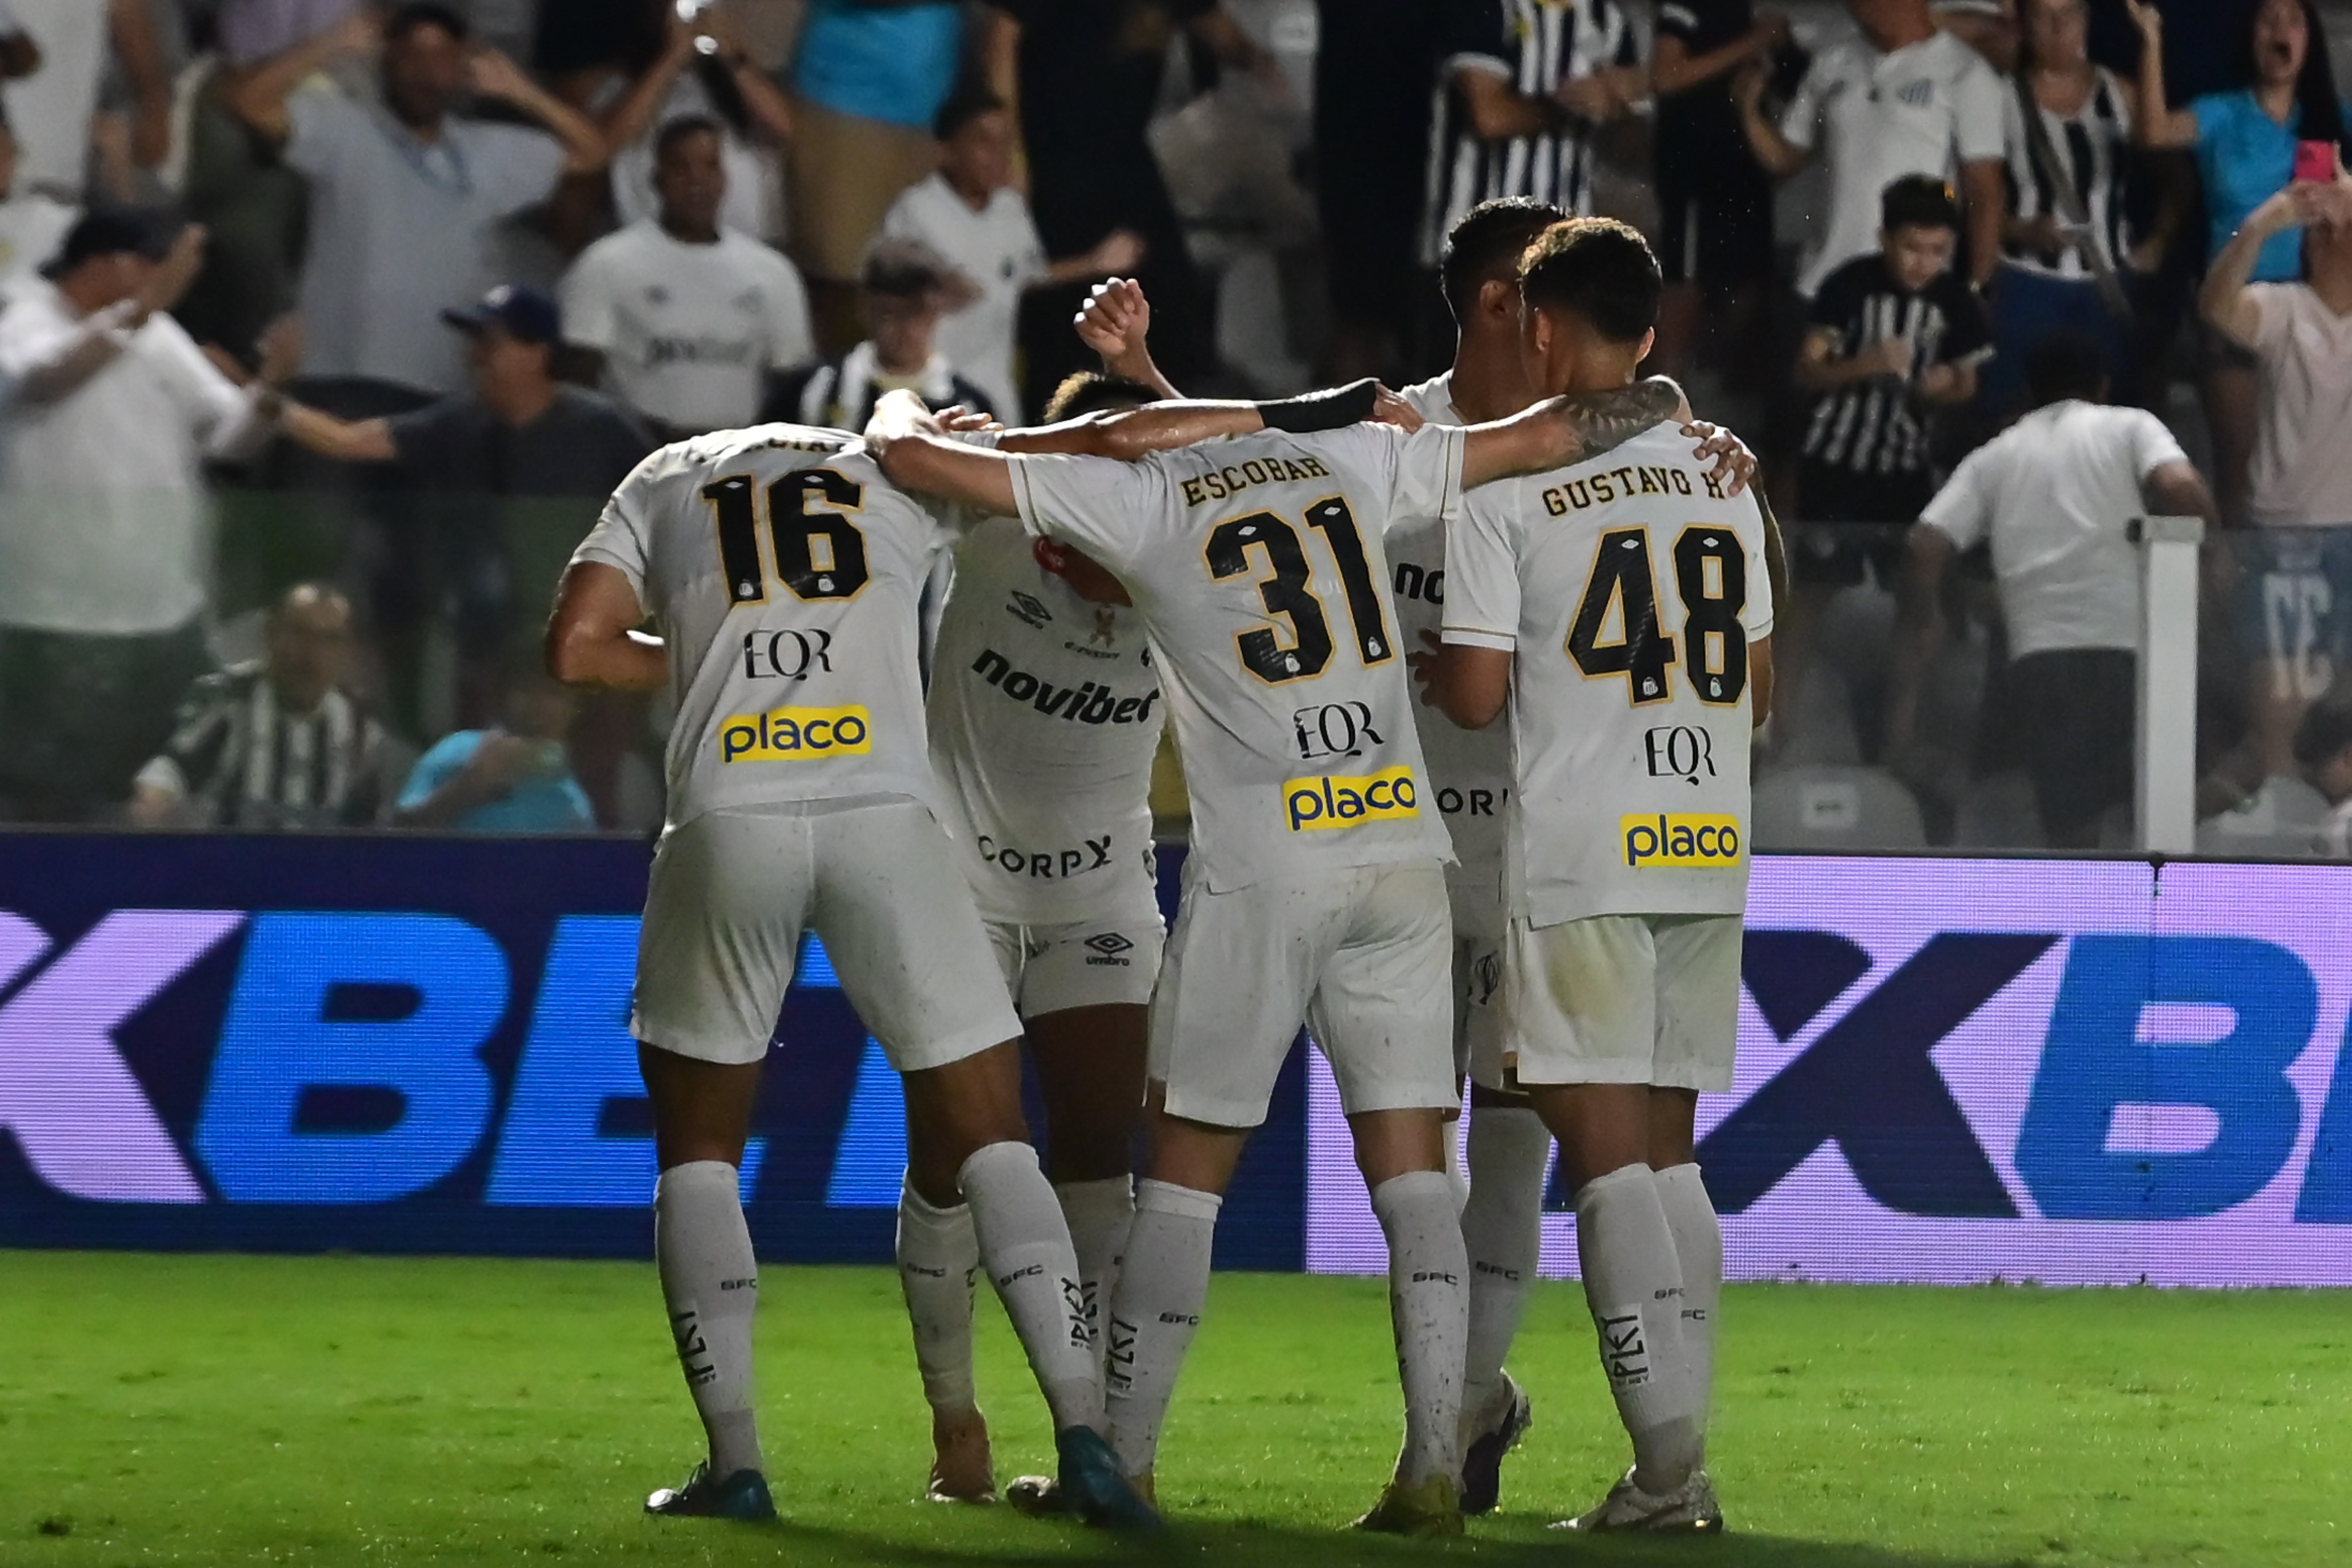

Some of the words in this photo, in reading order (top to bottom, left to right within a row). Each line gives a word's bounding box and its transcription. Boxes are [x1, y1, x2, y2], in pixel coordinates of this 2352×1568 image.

[1180, 457, 1330, 508] ESCOBAR
[1542, 466, 1691, 518] GUSTAVO
[701, 466, 872, 605] 16
[1204, 493, 1395, 688] 31
[1564, 522, 1749, 709] 48
[744, 628, 833, 681] EQR
[724, 712, 866, 763] placo
[1293, 700, 1385, 759] EQR
[1644, 726, 1717, 786] EQR
[1289, 777, 1416, 831] placo
[1626, 814, 1738, 866] placo
